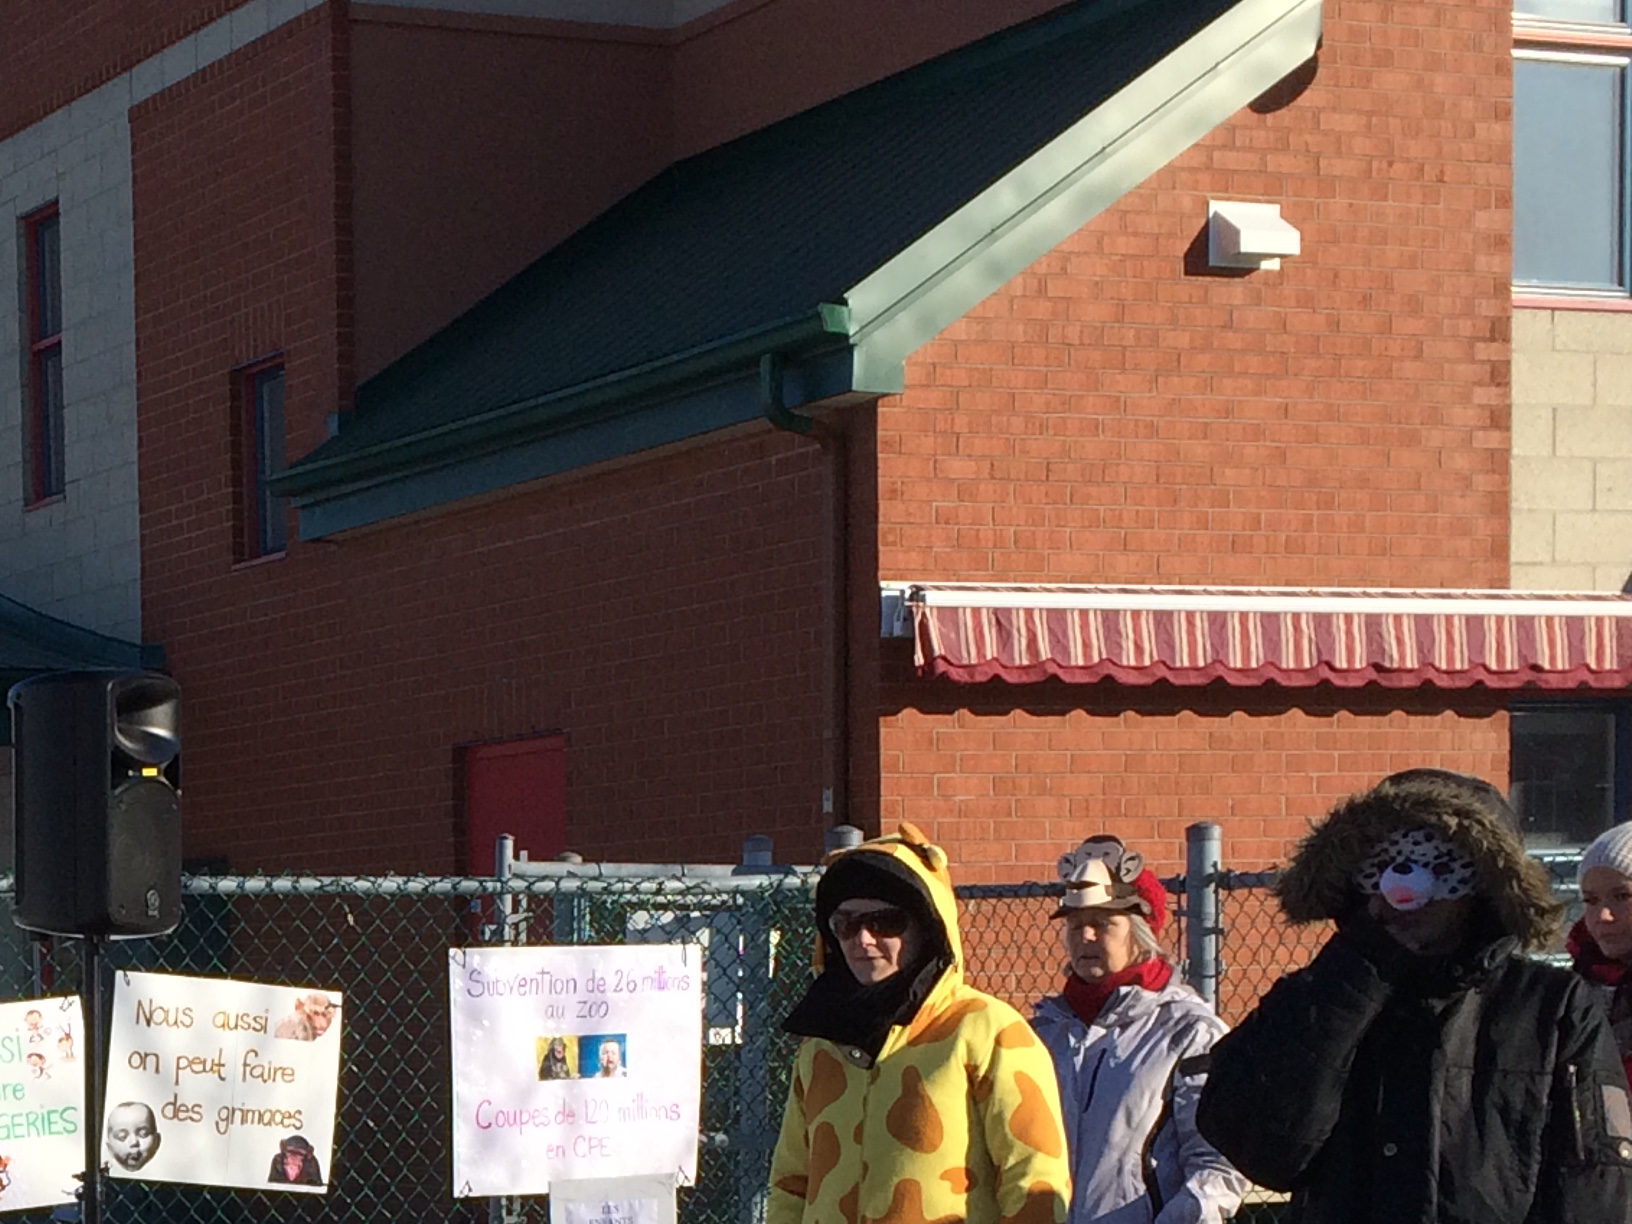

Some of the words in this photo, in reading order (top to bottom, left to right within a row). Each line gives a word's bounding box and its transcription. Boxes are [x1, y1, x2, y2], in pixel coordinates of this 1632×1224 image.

[466, 967, 578, 998] Subvention
[585, 969, 607, 994] de
[613, 969, 638, 993] 26
[135, 998, 194, 1029] Nous
[212, 1009, 269, 1035] aussi
[544, 1003, 565, 1020] au
[127, 1050, 161, 1074] on
[175, 1048, 227, 1086] peut
[242, 1049, 295, 1083] faire
[161, 1093, 203, 1123] des
[215, 1102, 304, 1135] grimaces
[475, 1100, 551, 1135] Coupes
[555, 1097, 576, 1125] de
[546, 1144, 566, 1160] en
[573, 1135, 611, 1158] CPE
